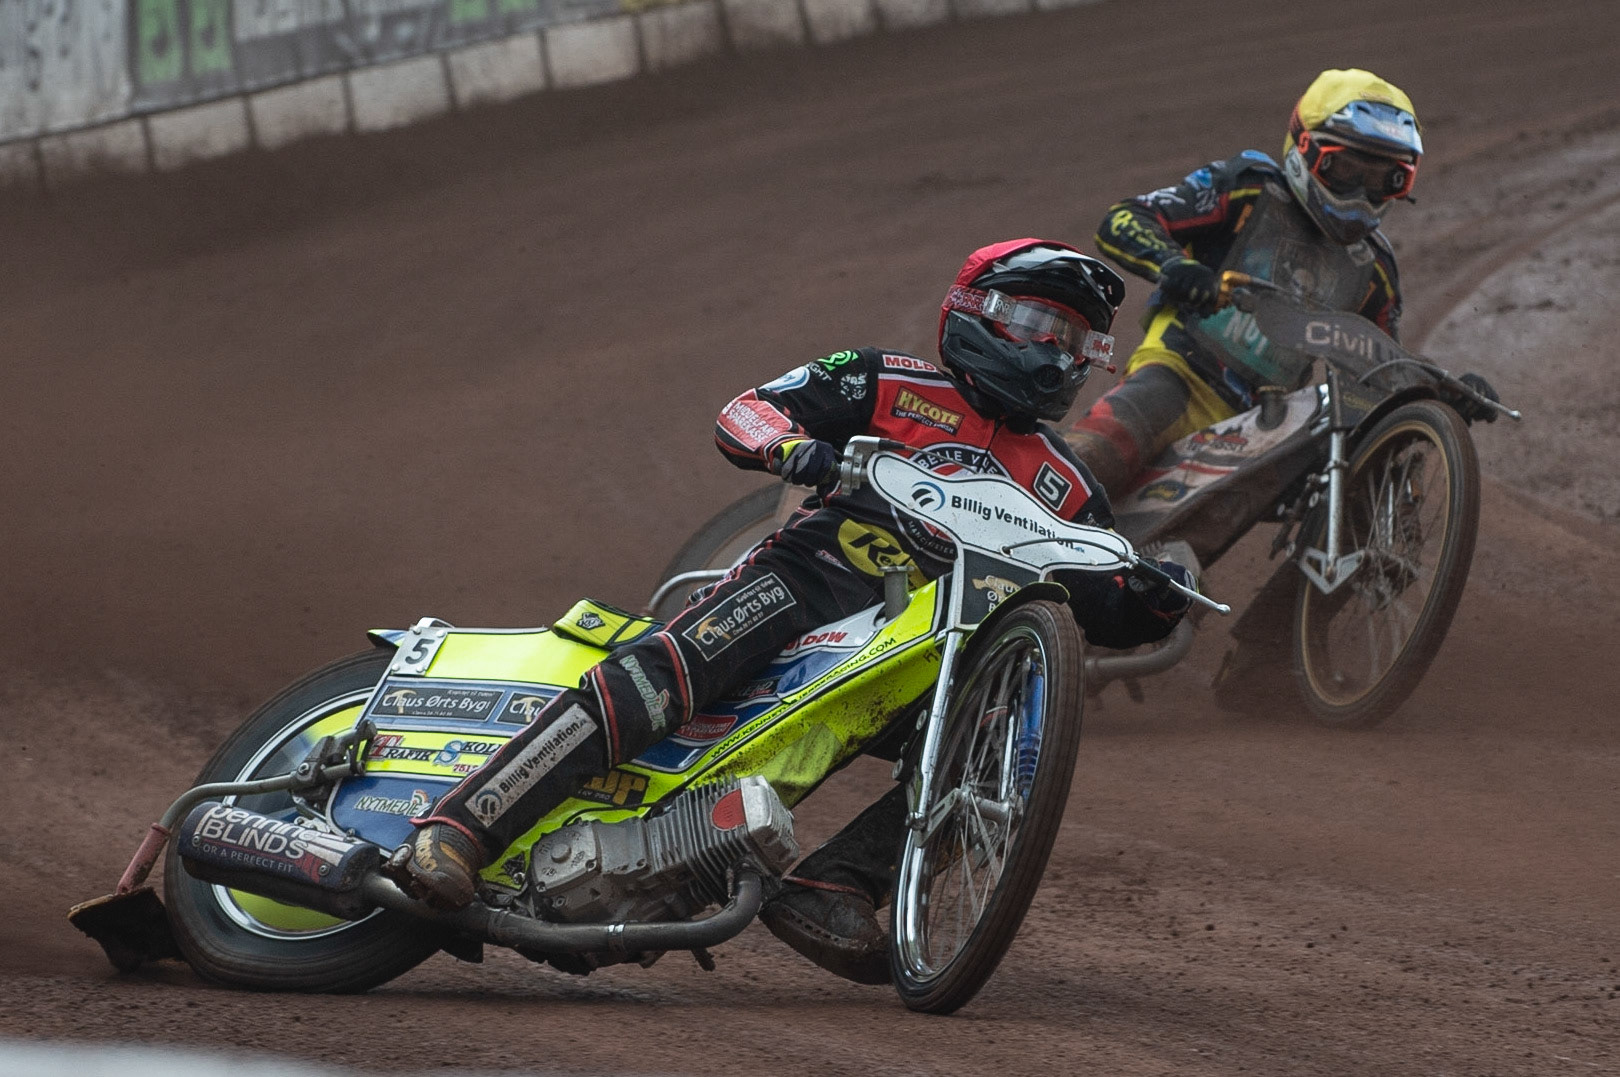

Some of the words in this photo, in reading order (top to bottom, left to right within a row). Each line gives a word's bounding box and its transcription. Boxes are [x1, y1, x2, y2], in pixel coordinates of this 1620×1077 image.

[1305, 321, 1373, 360] Civil
[898, 391, 960, 426] HYCOTE
[1039, 469, 1066, 501] 5
[951, 494, 993, 520] Billig
[699, 616, 737, 646] Claus
[732, 598, 763, 626] Ørts
[757, 585, 786, 606] Byg
[405, 638, 435, 665] 5
[382, 693, 424, 708] Claus
[424, 695, 457, 709] Ørts
[498, 766, 530, 794] Billig
[523, 722, 580, 771] Ventilation
[202, 819, 306, 860] BLINDS
[202, 844, 217, 854] OR
[220, 848, 228, 858] A
[230, 851, 275, 869] PERFECT
[277, 863, 295, 873] FIT
